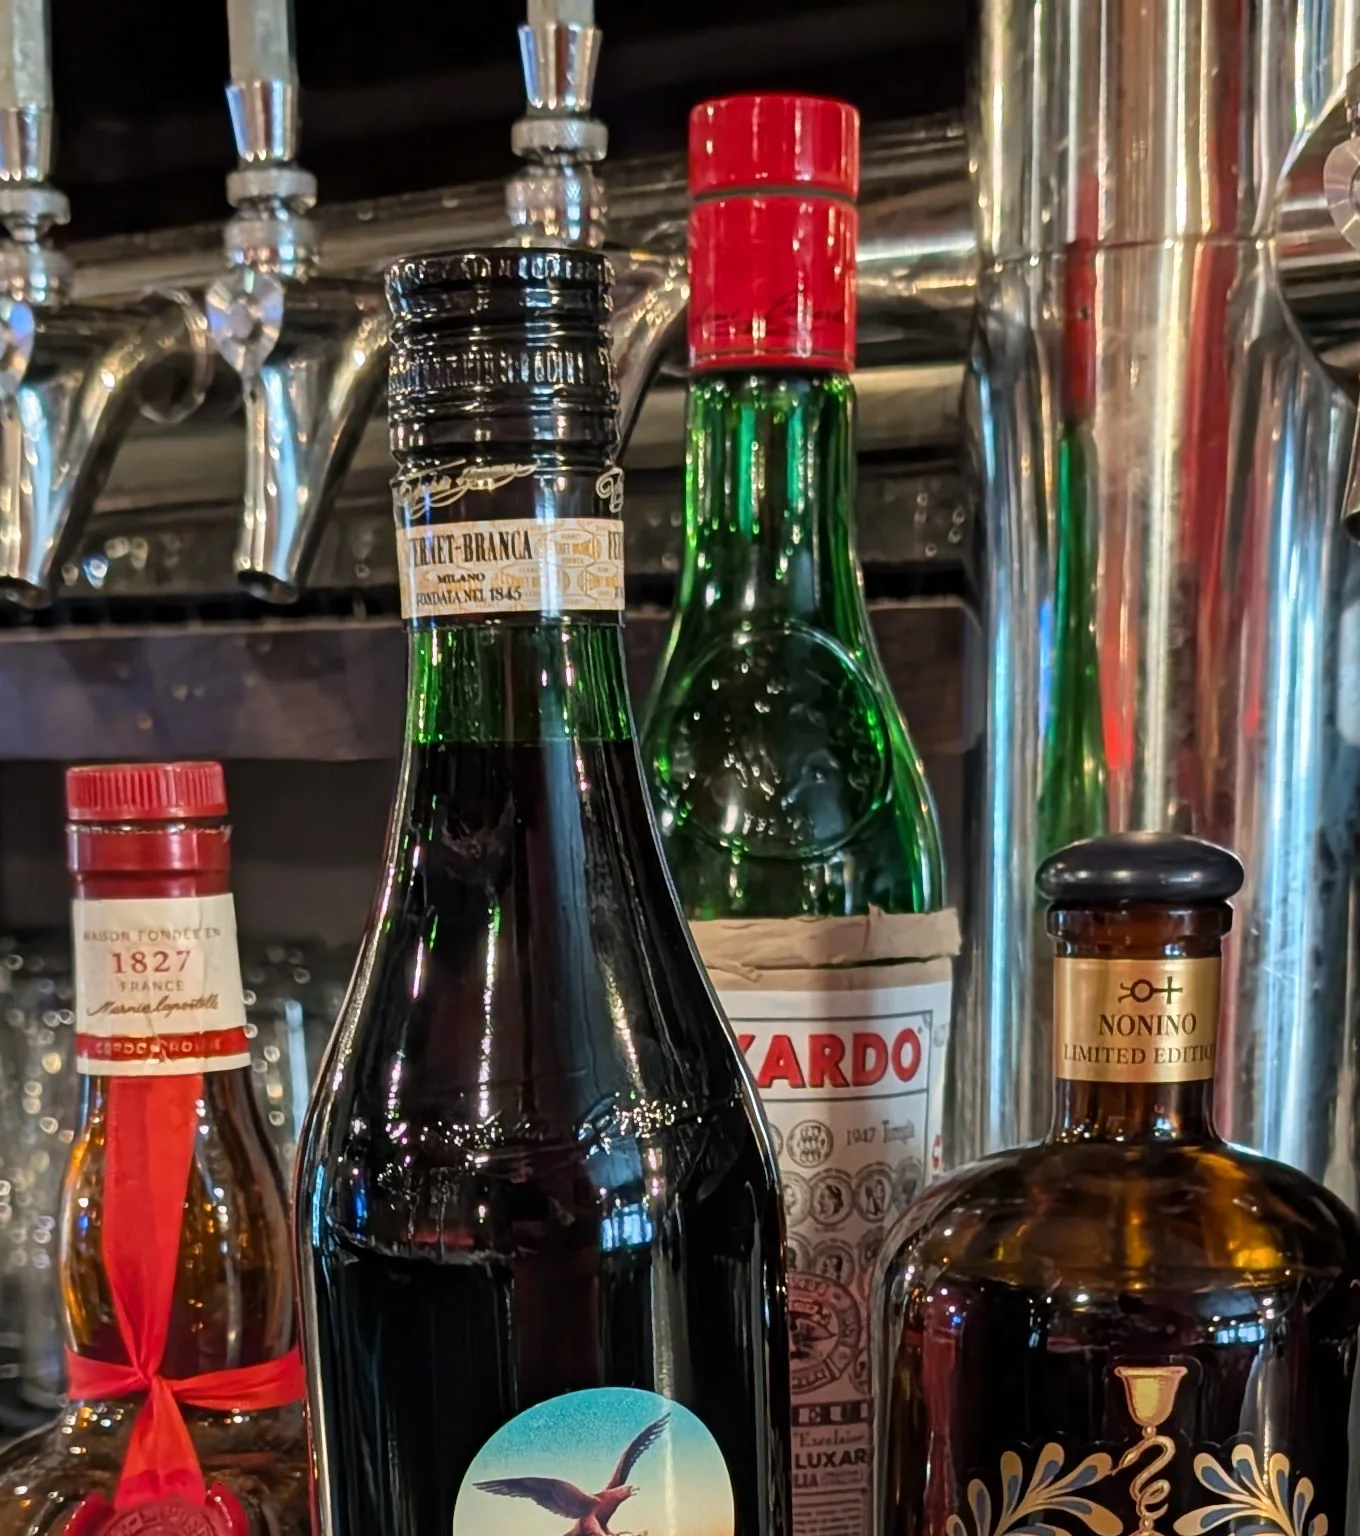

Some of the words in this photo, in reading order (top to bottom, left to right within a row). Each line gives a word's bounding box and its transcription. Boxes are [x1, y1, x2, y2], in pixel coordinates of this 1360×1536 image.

[408, 530, 533, 567] ERNET-BRANCA
[437, 572, 486, 584] MILANO
[463, 588, 486, 602] NEL
[490, 585, 522, 602] 1845
[112, 950, 191, 974] 1827
[120, 979, 185, 992] FRANCE
[1098, 1012, 1197, 1036] NONINO
[1063, 1043, 1146, 1065] LIMITED
